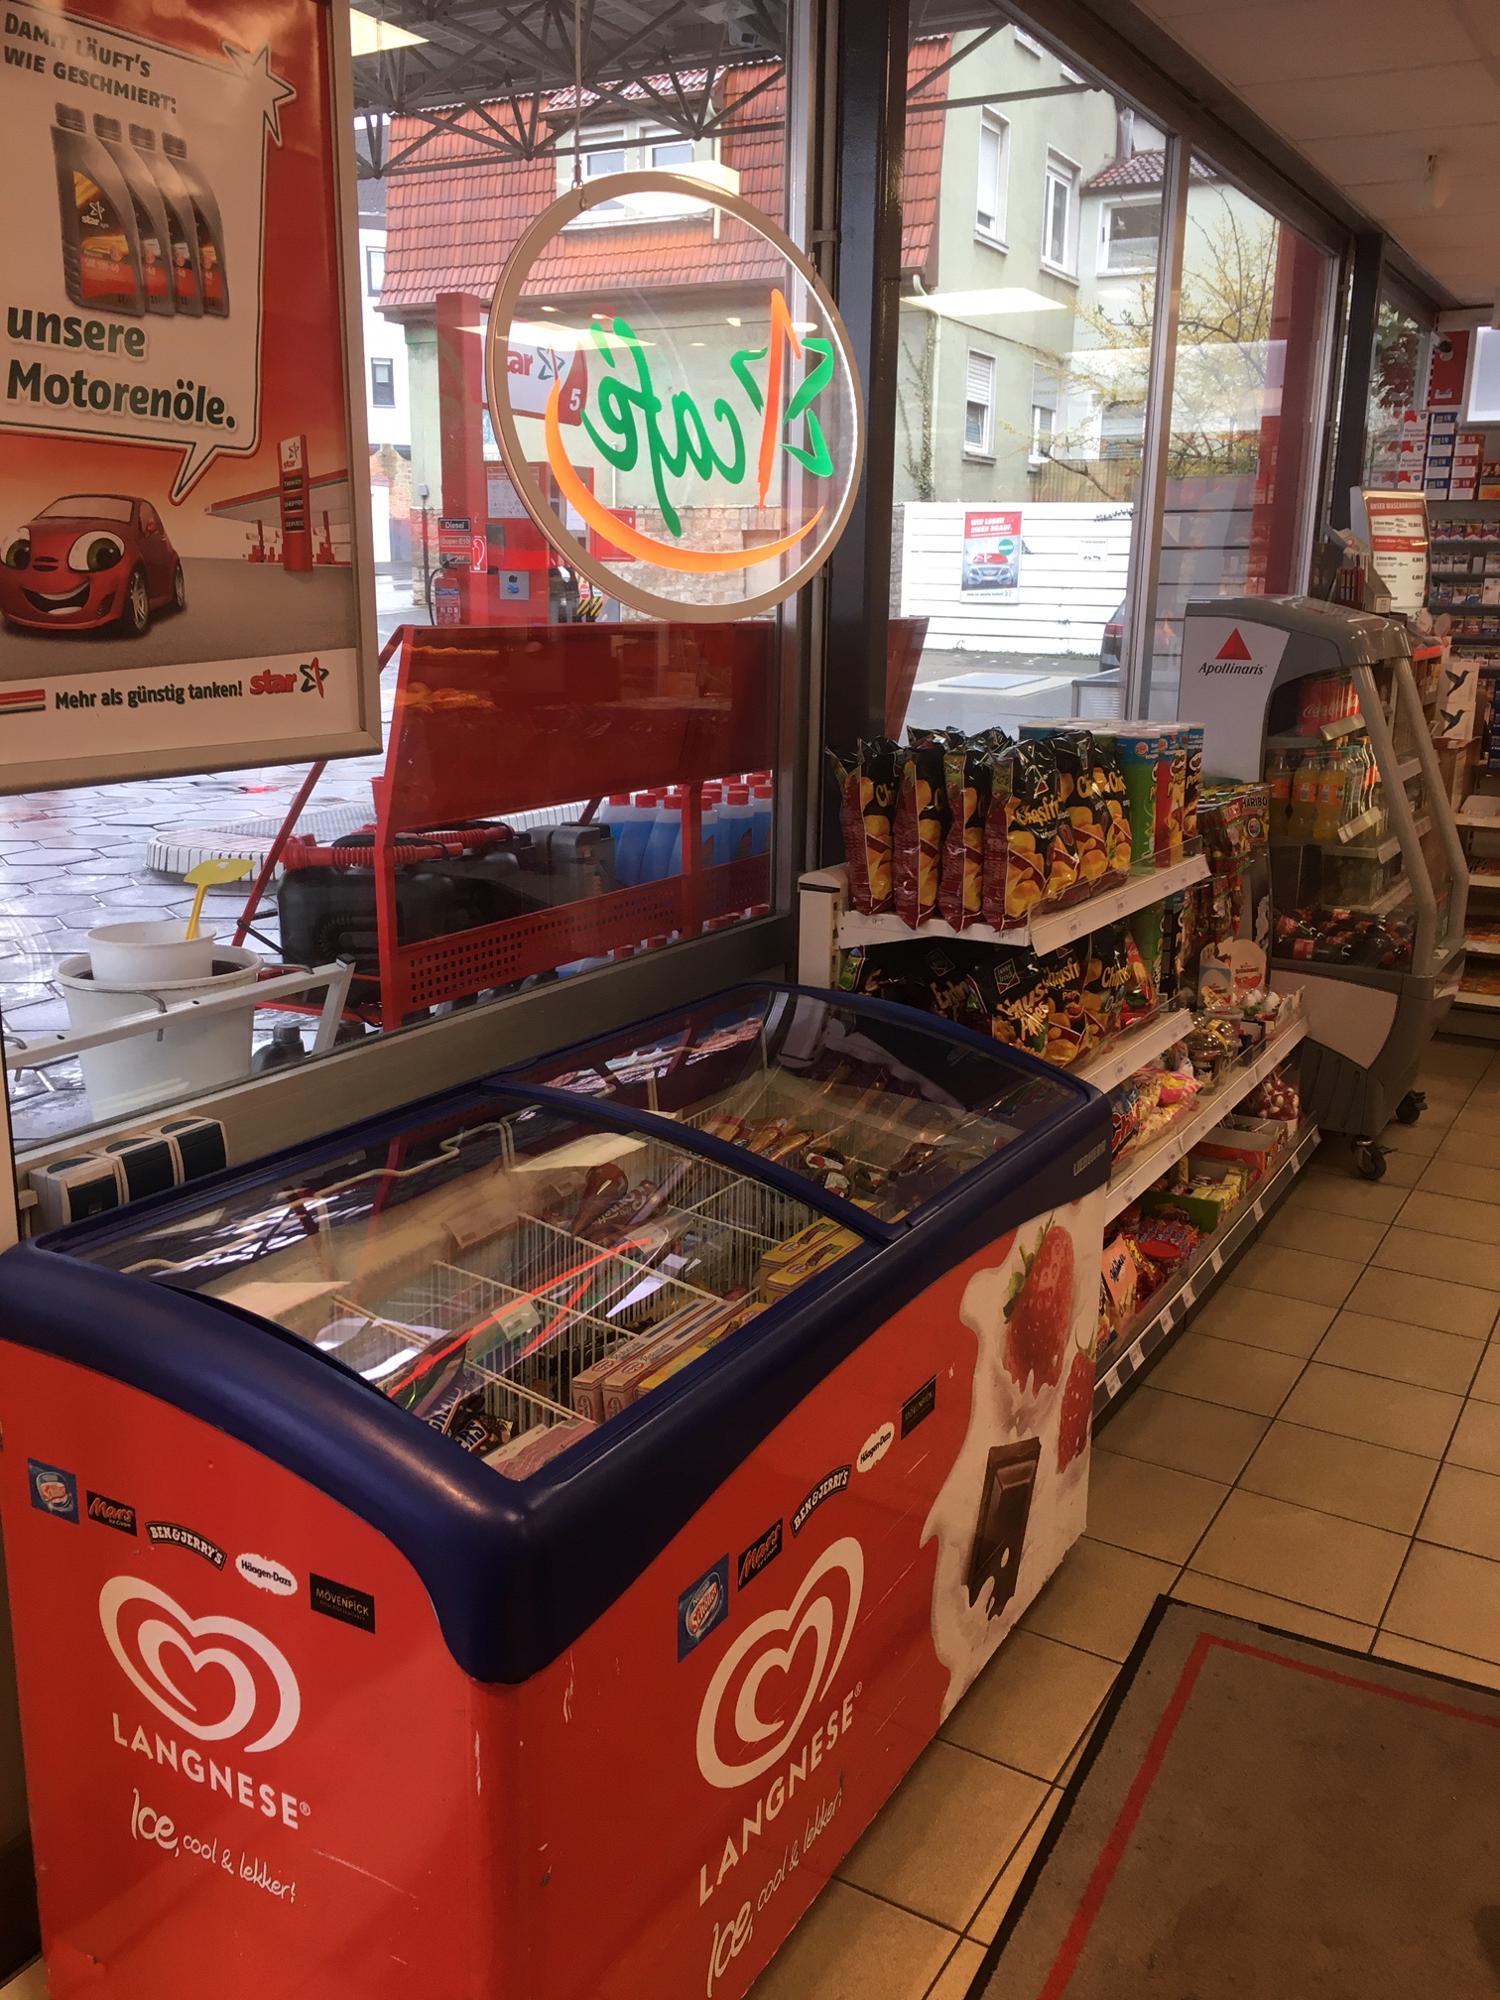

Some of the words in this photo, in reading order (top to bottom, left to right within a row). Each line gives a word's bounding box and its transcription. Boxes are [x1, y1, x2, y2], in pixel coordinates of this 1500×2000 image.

[76, 36, 152, 79] LÄUFT'S
[4, 45, 46, 75] WIE
[52, 62, 178, 115] GESCHMIERT:
[6, 306, 146, 357] unsere
[6, 359, 236, 429] Motorenöle.
[569, 388, 581, 412] 5
[445, 521, 465, 529] Diesel
[1198, 661, 1265, 676] Apollinaris
[55, 690, 97, 710] Mehr
[100, 687, 123, 706] als
[127, 683, 185, 708] günstig
[187, 680, 243, 699] tanken!
[250, 669, 297, 696] star
[88, 1497, 134, 1523] Mars
[241, 1559, 292, 1587] Häagen-Dazs
[315, 1587, 369, 1616] MÖVENPICK
[183, 1834, 218, 1865] cool
[222, 1849, 234, 1876] &
[239, 1852, 297, 1903] lekker!
[757, 1845, 789, 1912] cool
